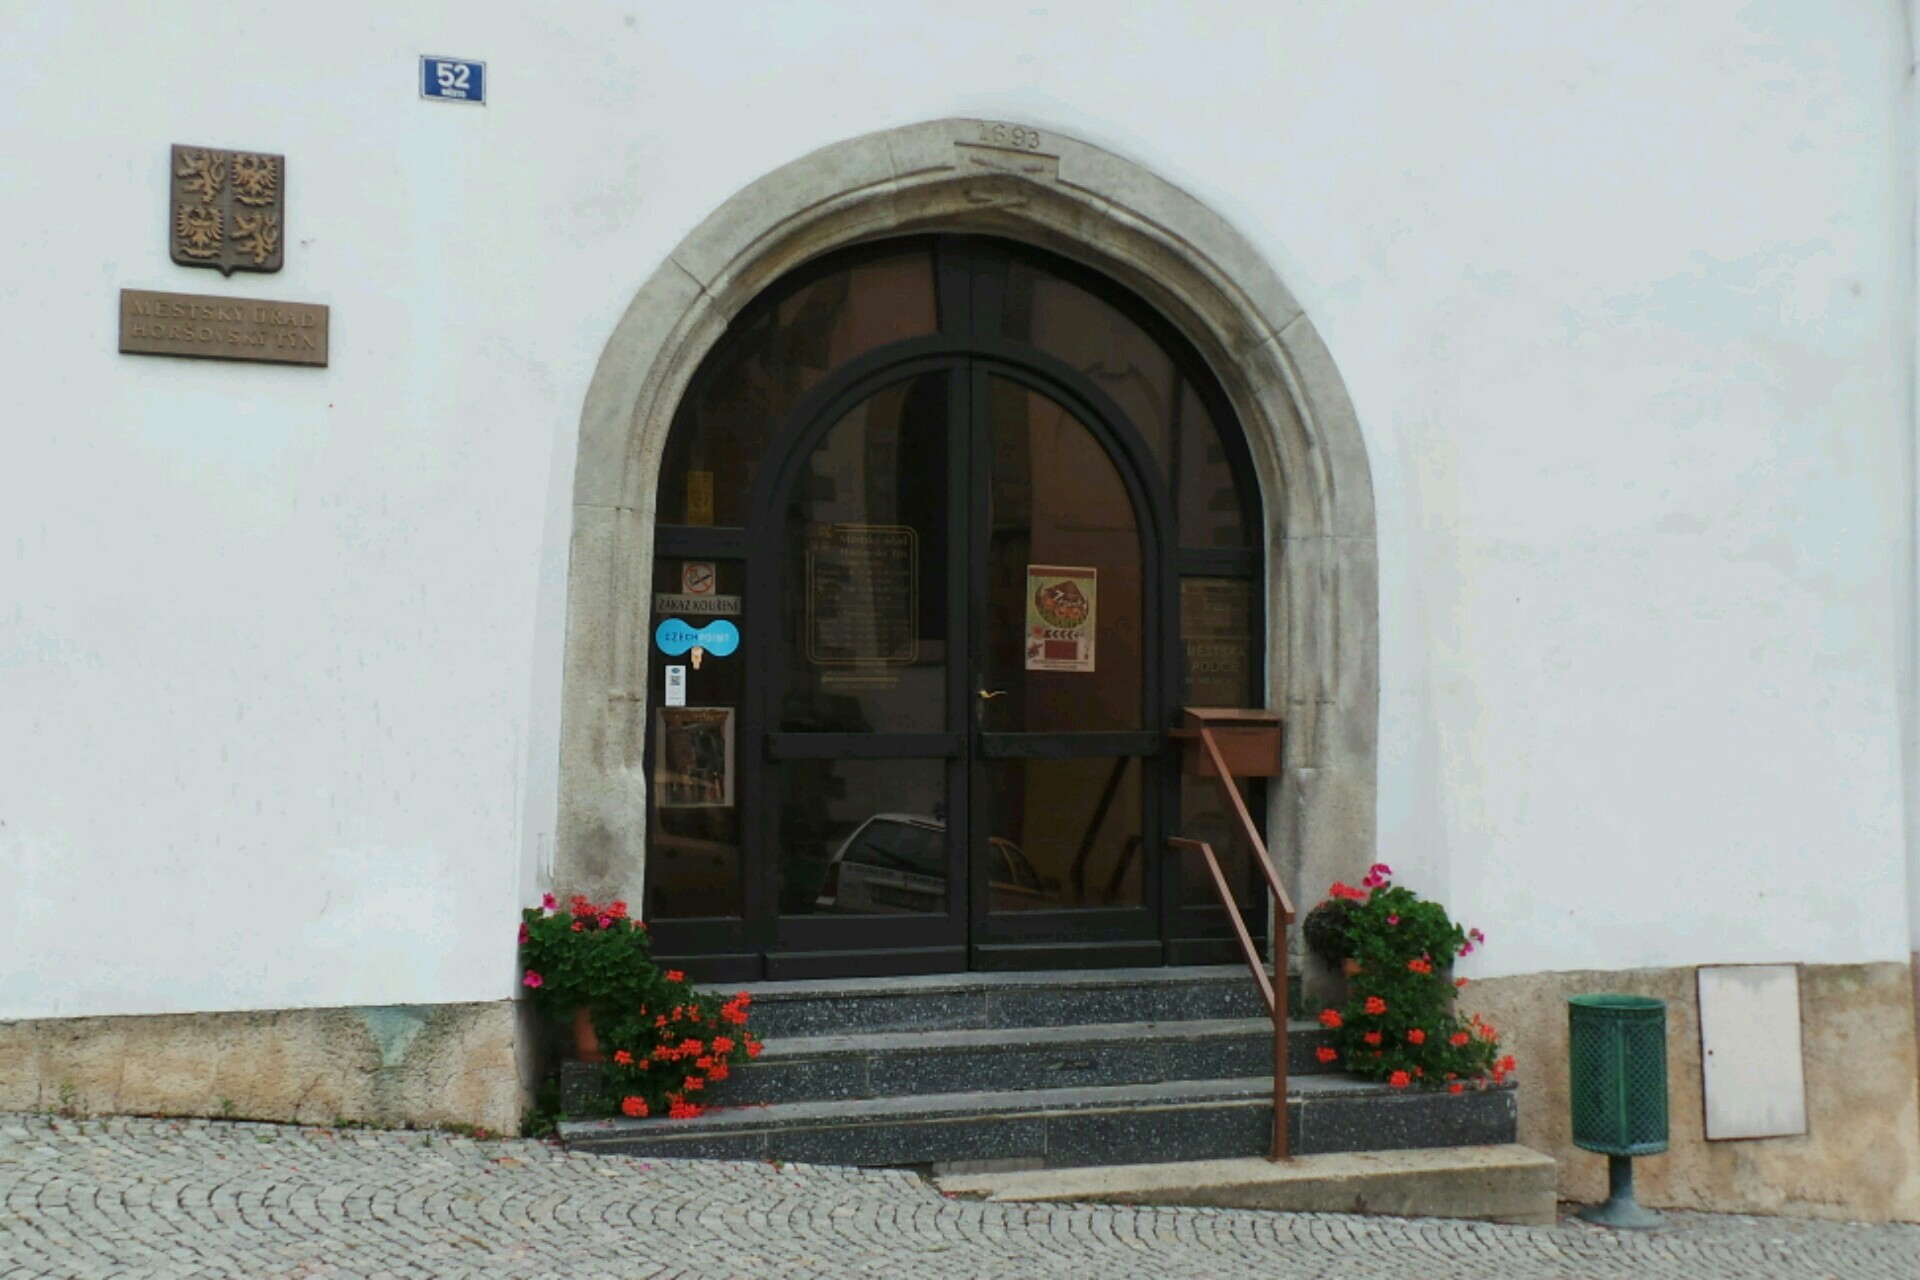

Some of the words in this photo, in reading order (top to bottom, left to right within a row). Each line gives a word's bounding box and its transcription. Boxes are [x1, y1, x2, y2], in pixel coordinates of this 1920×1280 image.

[436, 62, 470, 89] 52
[132, 323, 266, 346] HORŠOVSKÝ
[658, 596, 690, 610] ZÁKAZ
[692, 598, 739, 611] KOUŘENÍ
